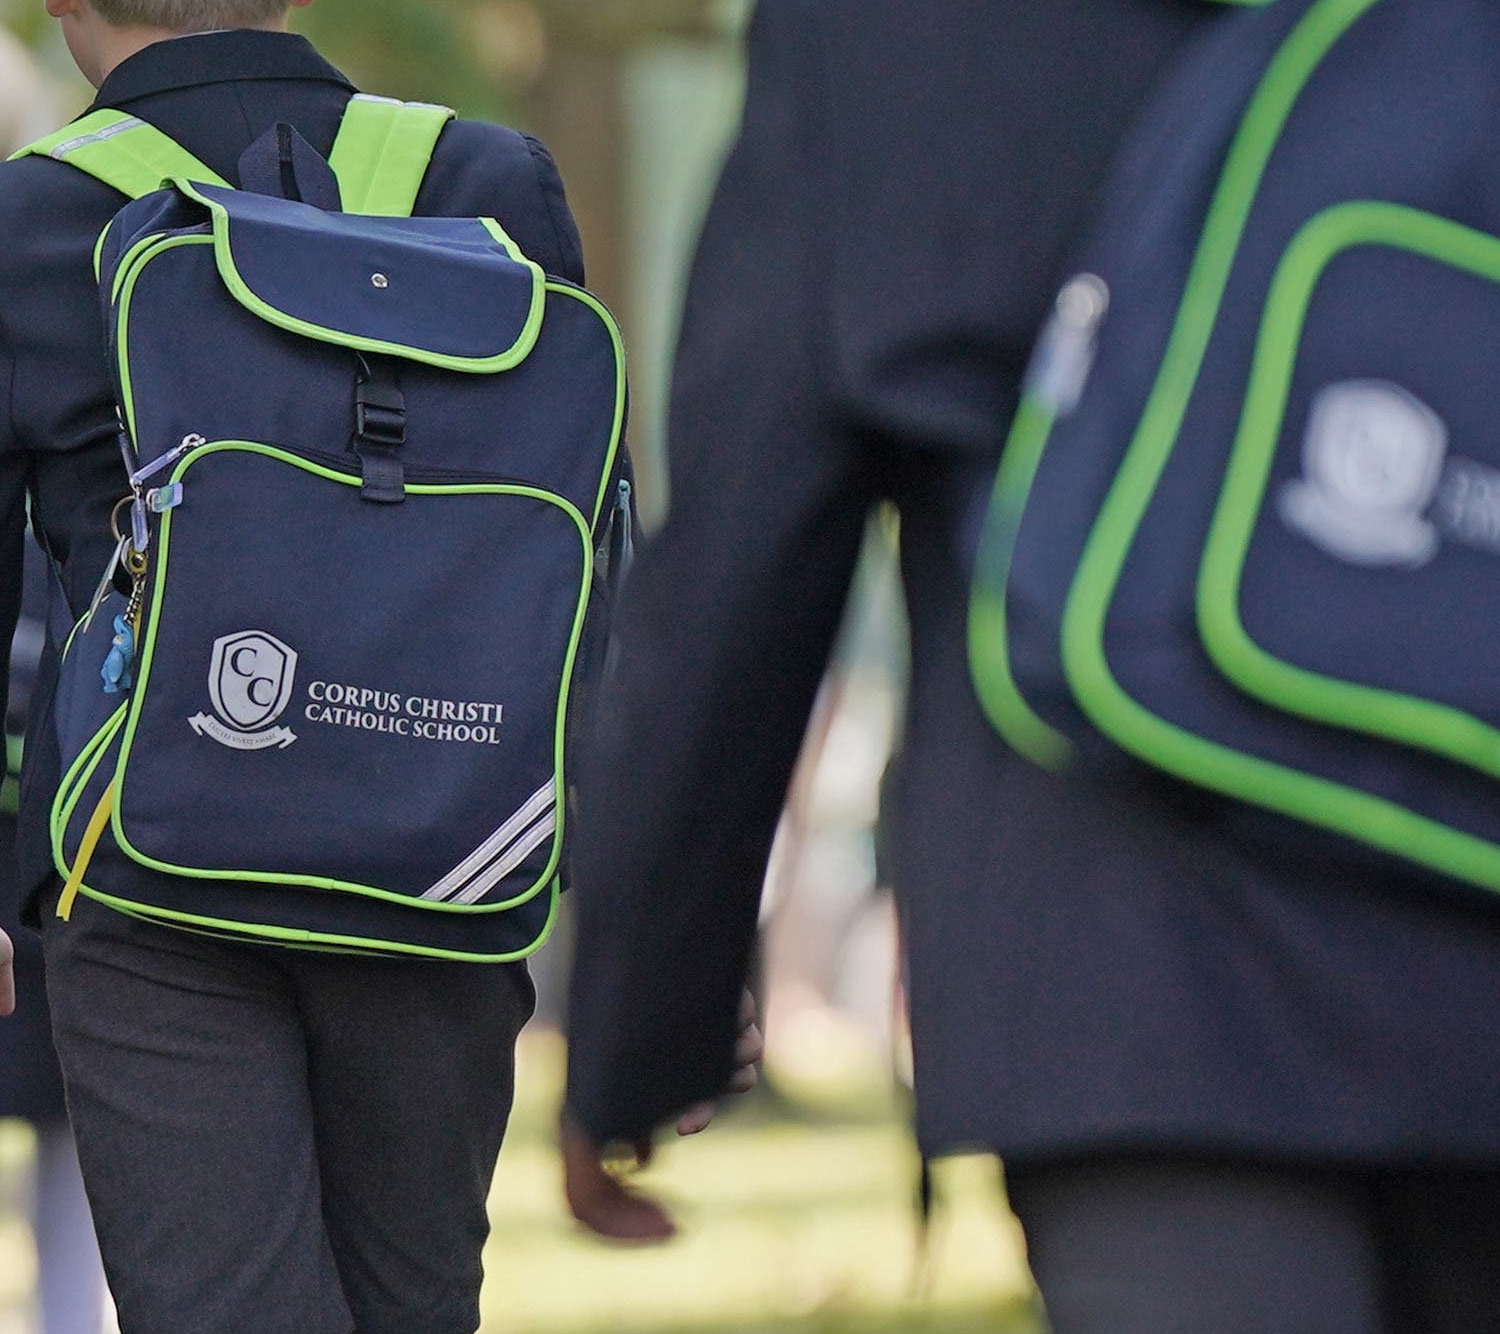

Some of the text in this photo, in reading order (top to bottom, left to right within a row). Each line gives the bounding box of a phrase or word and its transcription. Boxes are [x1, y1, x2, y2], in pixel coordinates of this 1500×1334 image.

[304, 703, 500, 744] CATHOLIC SCHOOL
[308, 681, 504, 724] CORPUS CHRISTI
